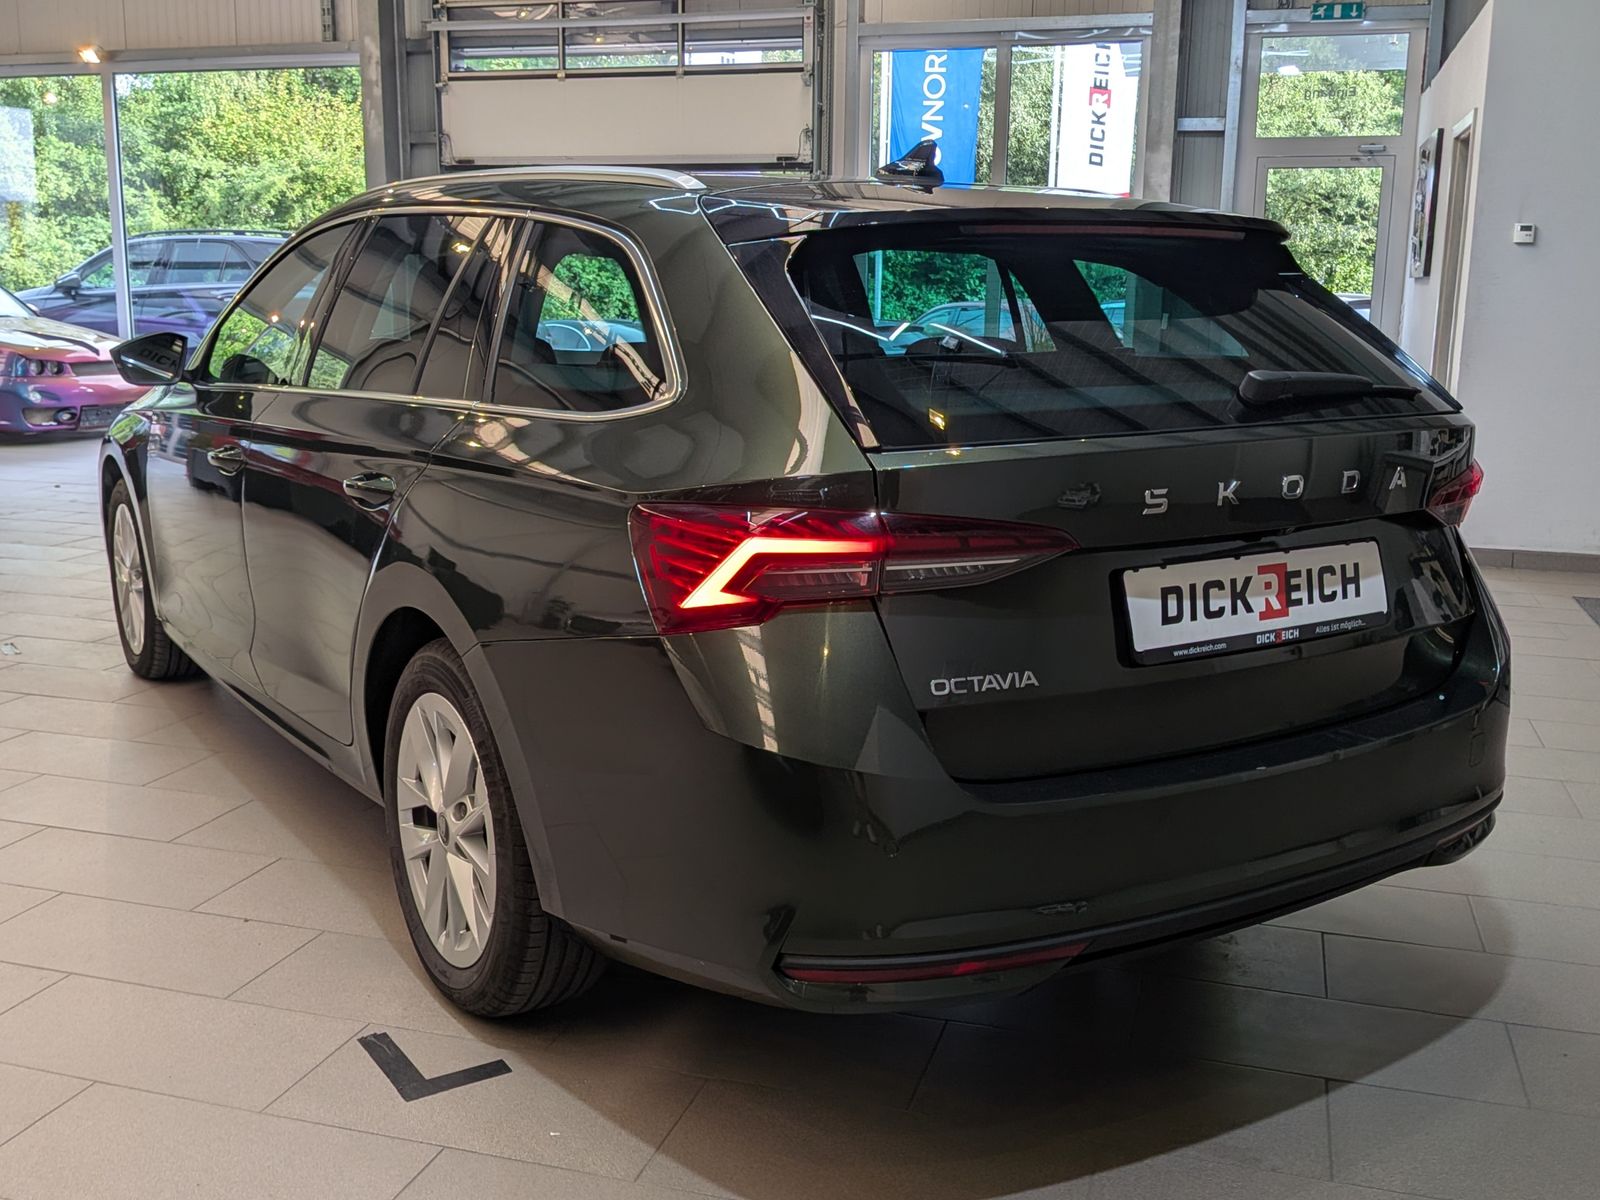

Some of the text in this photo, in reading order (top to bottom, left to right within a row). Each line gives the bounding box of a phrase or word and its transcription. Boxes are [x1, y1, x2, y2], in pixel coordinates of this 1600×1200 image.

[1160, 562, 1361, 626] DICKREICH
[1256, 628, 1300, 645] DICKREICH
[1315, 625, 1330, 634] Alles
[1331, 623, 1340, 632] ist
[1173, 643, 1227, 657] www.dickreich.com
[930, 670, 1040, 696] OCTAVIA
